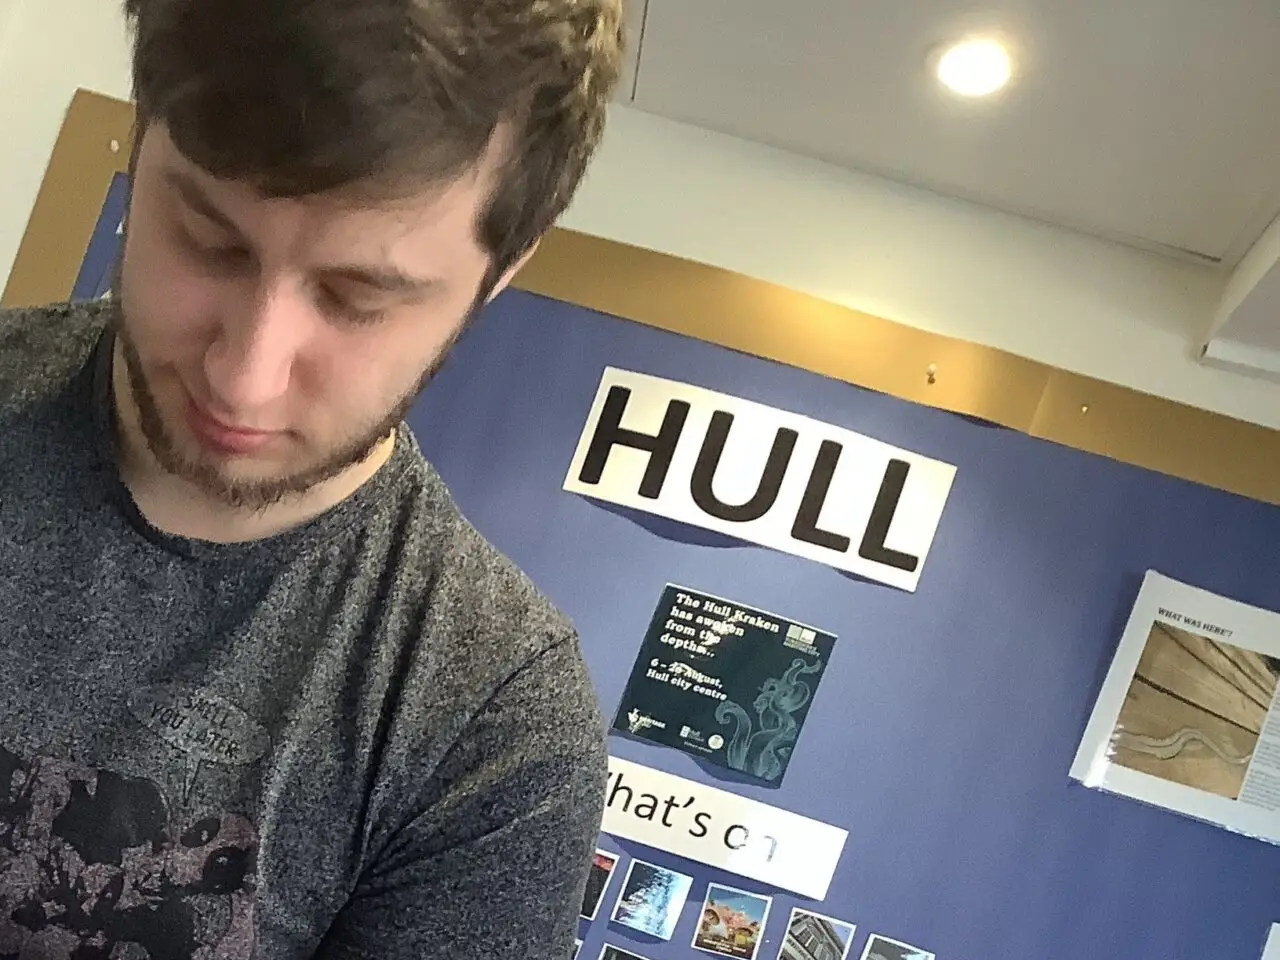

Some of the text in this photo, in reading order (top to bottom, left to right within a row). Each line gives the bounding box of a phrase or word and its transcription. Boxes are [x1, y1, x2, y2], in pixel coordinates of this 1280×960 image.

[578, 385, 919, 572] HULL
[665, 619, 696, 636] from
[670, 606, 693, 620] has
[677, 593, 780, 633] The Hull Kraken
[1158, 607, 1182, 621] WHAT
[1184, 616, 1201, 629] WAS
[646, 668, 727, 700] Hull city centre
[150, 703, 240, 759] YOU LATER
[607, 772, 712, 838] hat's
